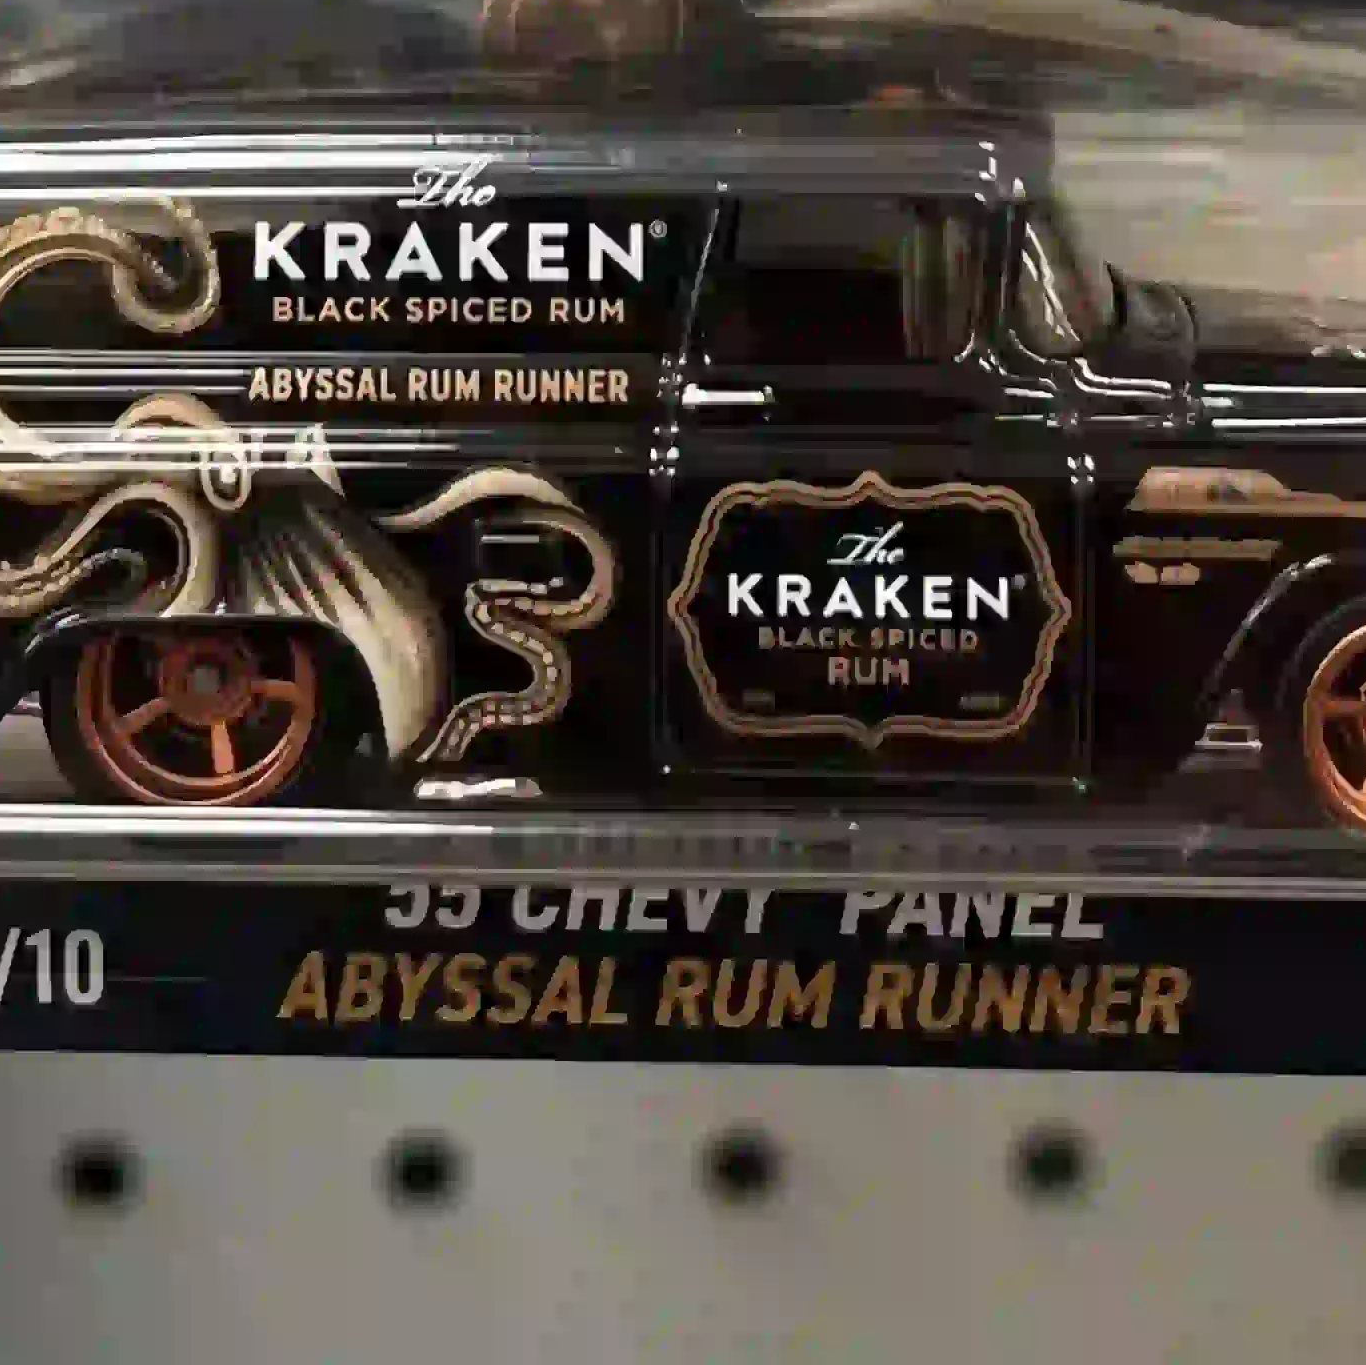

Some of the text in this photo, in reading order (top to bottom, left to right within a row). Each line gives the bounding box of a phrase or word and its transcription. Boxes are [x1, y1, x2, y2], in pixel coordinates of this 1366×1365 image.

[274, 297, 624, 323] BLACK SPICED RUM
[248, 368, 628, 403] ABYSSAL RUM RUNNER
[827, 522, 903, 565] The
[759, 627, 979, 651] BLACK SPICED
[828, 657, 909, 686] RUM
[276, 952, 1187, 1033] ABYSSAL RUM RUNNER
